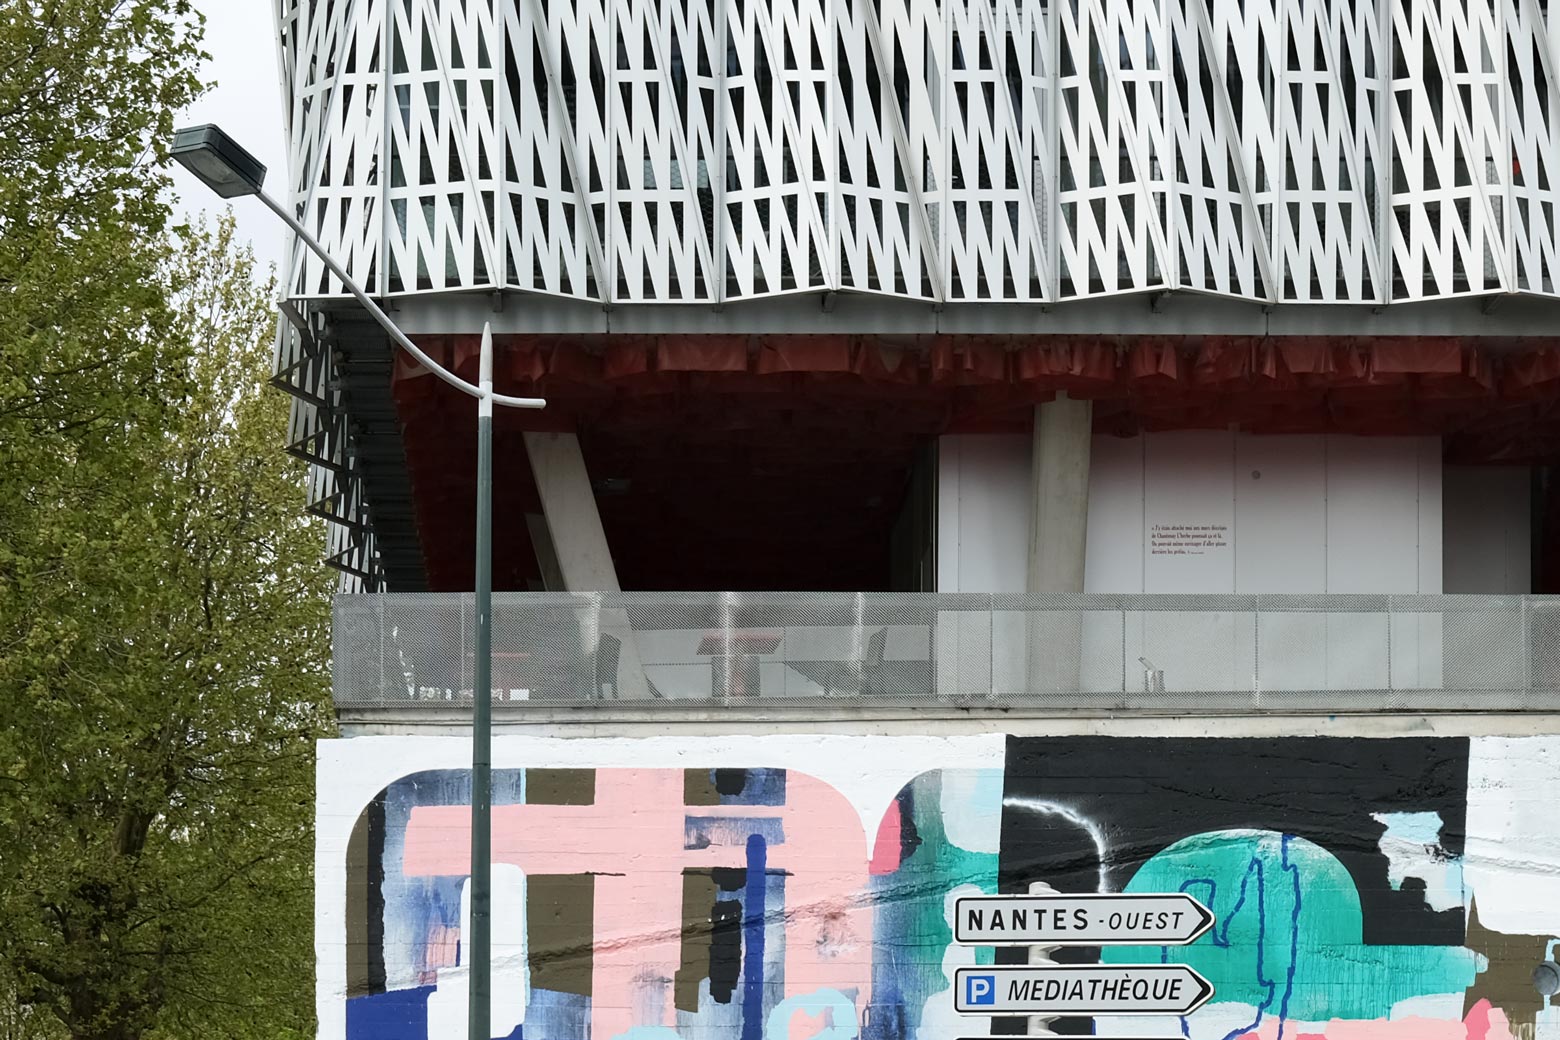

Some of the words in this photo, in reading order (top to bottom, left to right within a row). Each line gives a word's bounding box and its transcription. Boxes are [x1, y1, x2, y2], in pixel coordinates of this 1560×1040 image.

[968, 908, 1089, 931] NANTES
[971, 979, 990, 1003] P
[1008, 973, 1183, 1001] MEDIATHÈQUE
